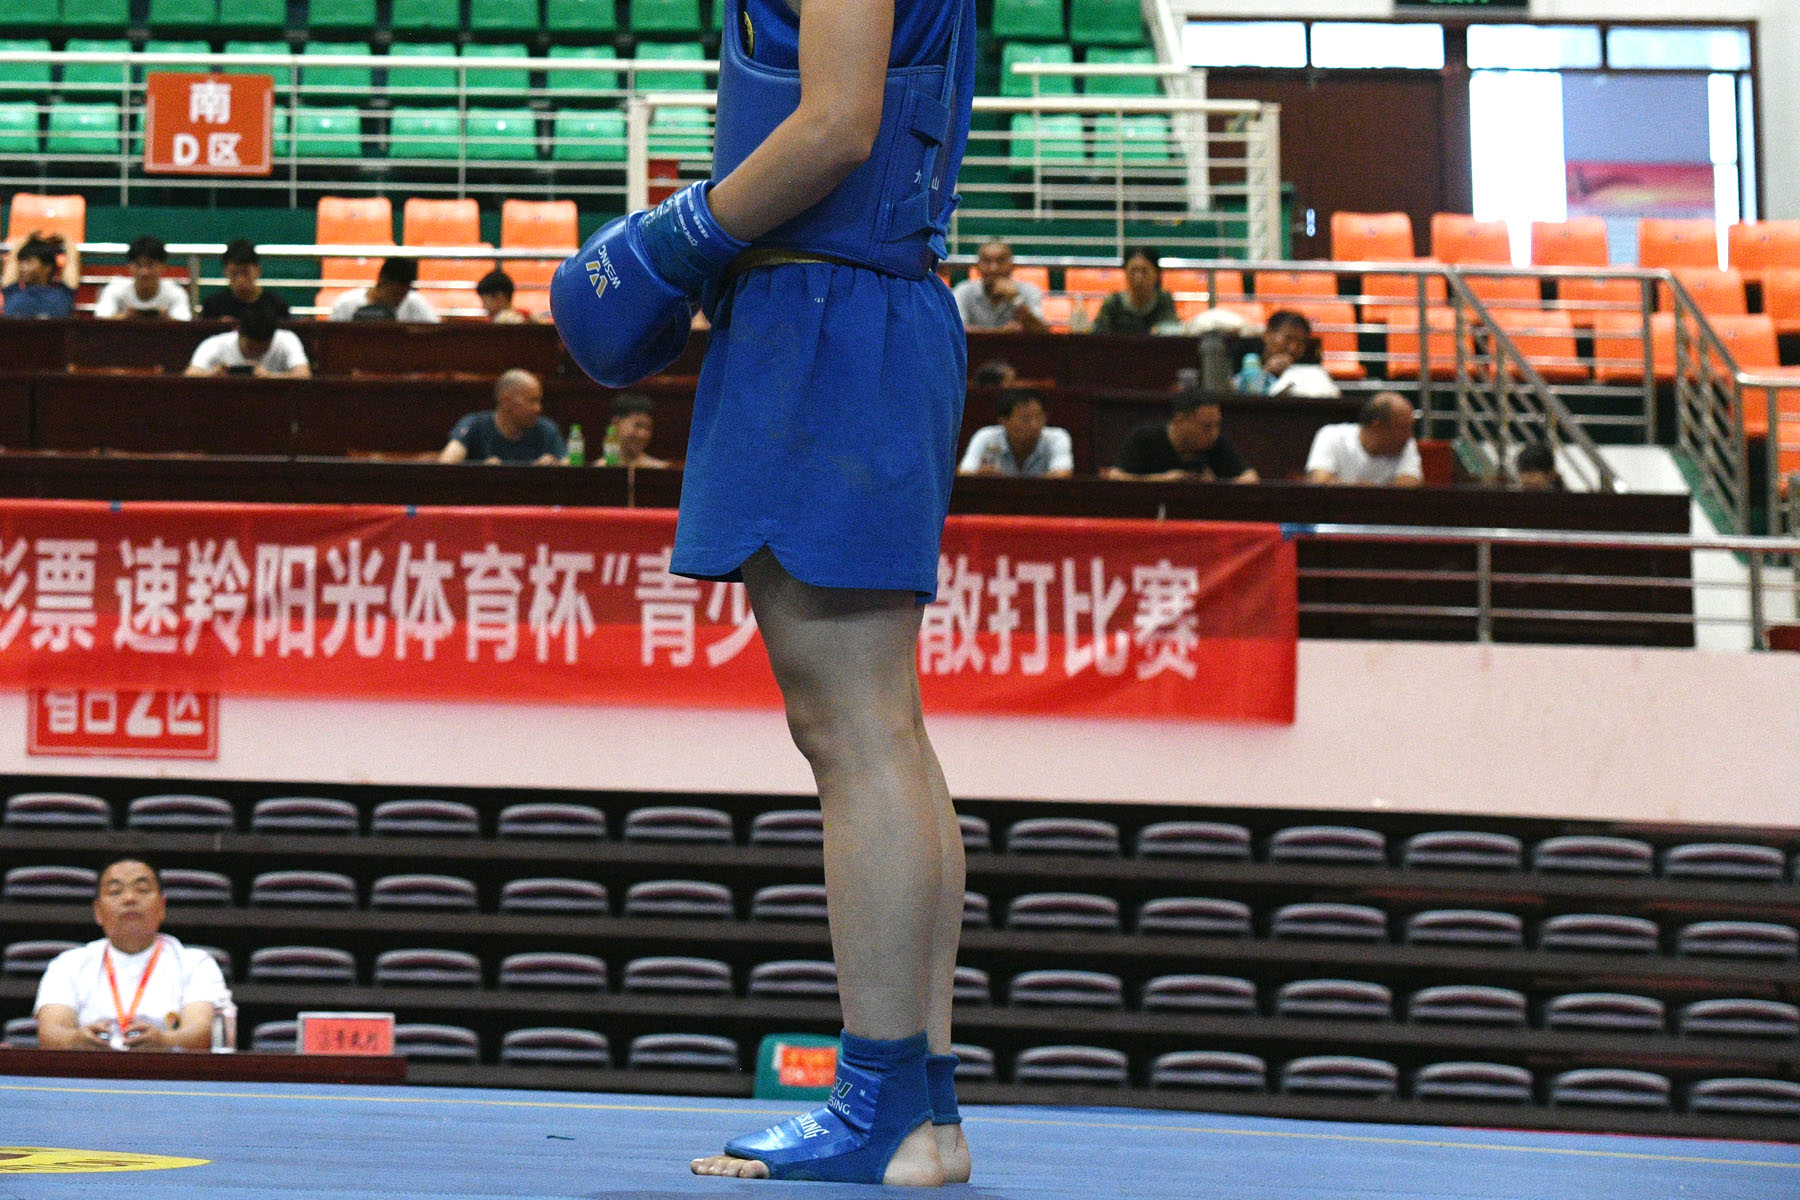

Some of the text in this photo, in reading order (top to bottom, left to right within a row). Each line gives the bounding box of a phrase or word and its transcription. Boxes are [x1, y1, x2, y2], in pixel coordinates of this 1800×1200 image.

[189, 79, 232, 124] 南
[598, 244, 621, 289] WESING
[826, 1096, 851, 1116] SING
[796, 1112, 831, 1140] SING
